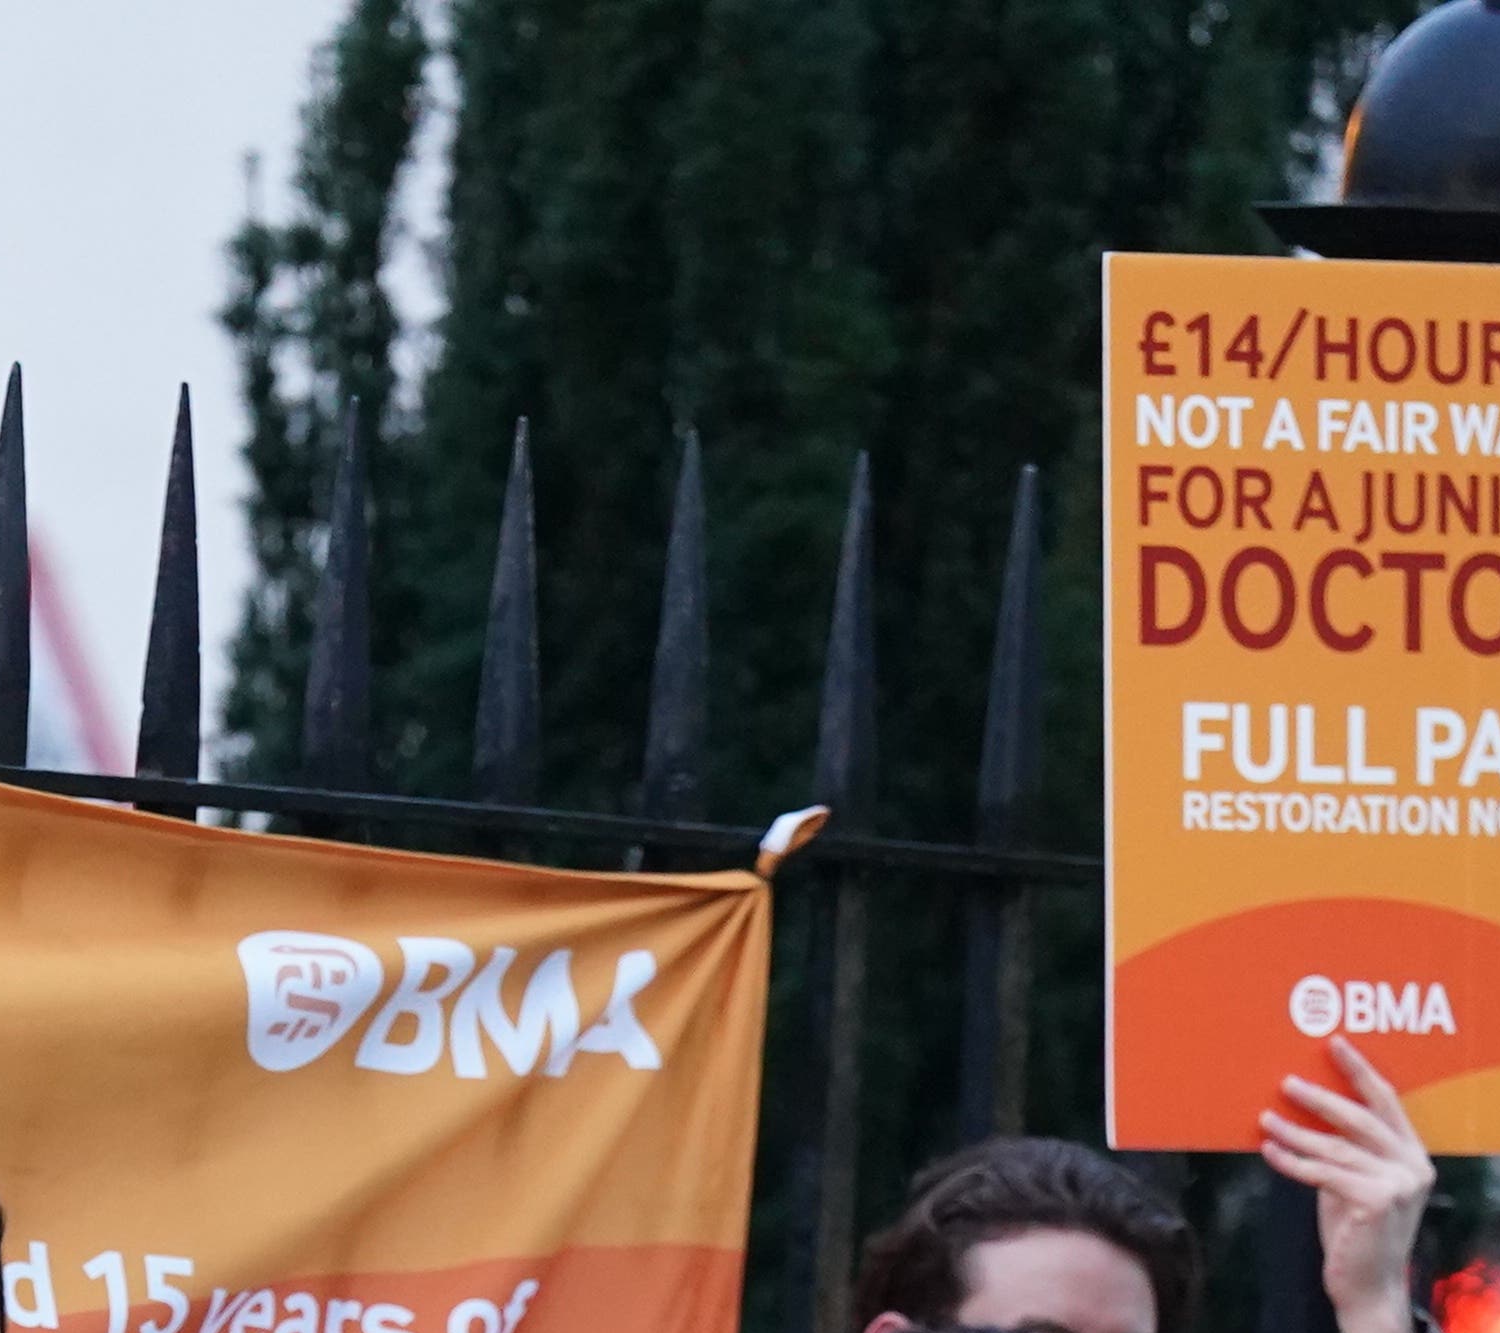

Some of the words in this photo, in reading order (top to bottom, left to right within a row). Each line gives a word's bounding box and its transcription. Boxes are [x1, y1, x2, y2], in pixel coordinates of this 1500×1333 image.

[1136, 395, 1253, 450] NOT
[1264, 398, 1305, 451] A
[1317, 400, 1438, 455] FAIR
[1138, 466, 1272, 530] FOR
[1295, 471, 1339, 531] A
[1183, 702, 1395, 785] FULL
[1183, 792, 1458, 835] RESTORATION
[355, 938, 662, 1078] BMA
[1345, 981, 1455, 1034] BMA
